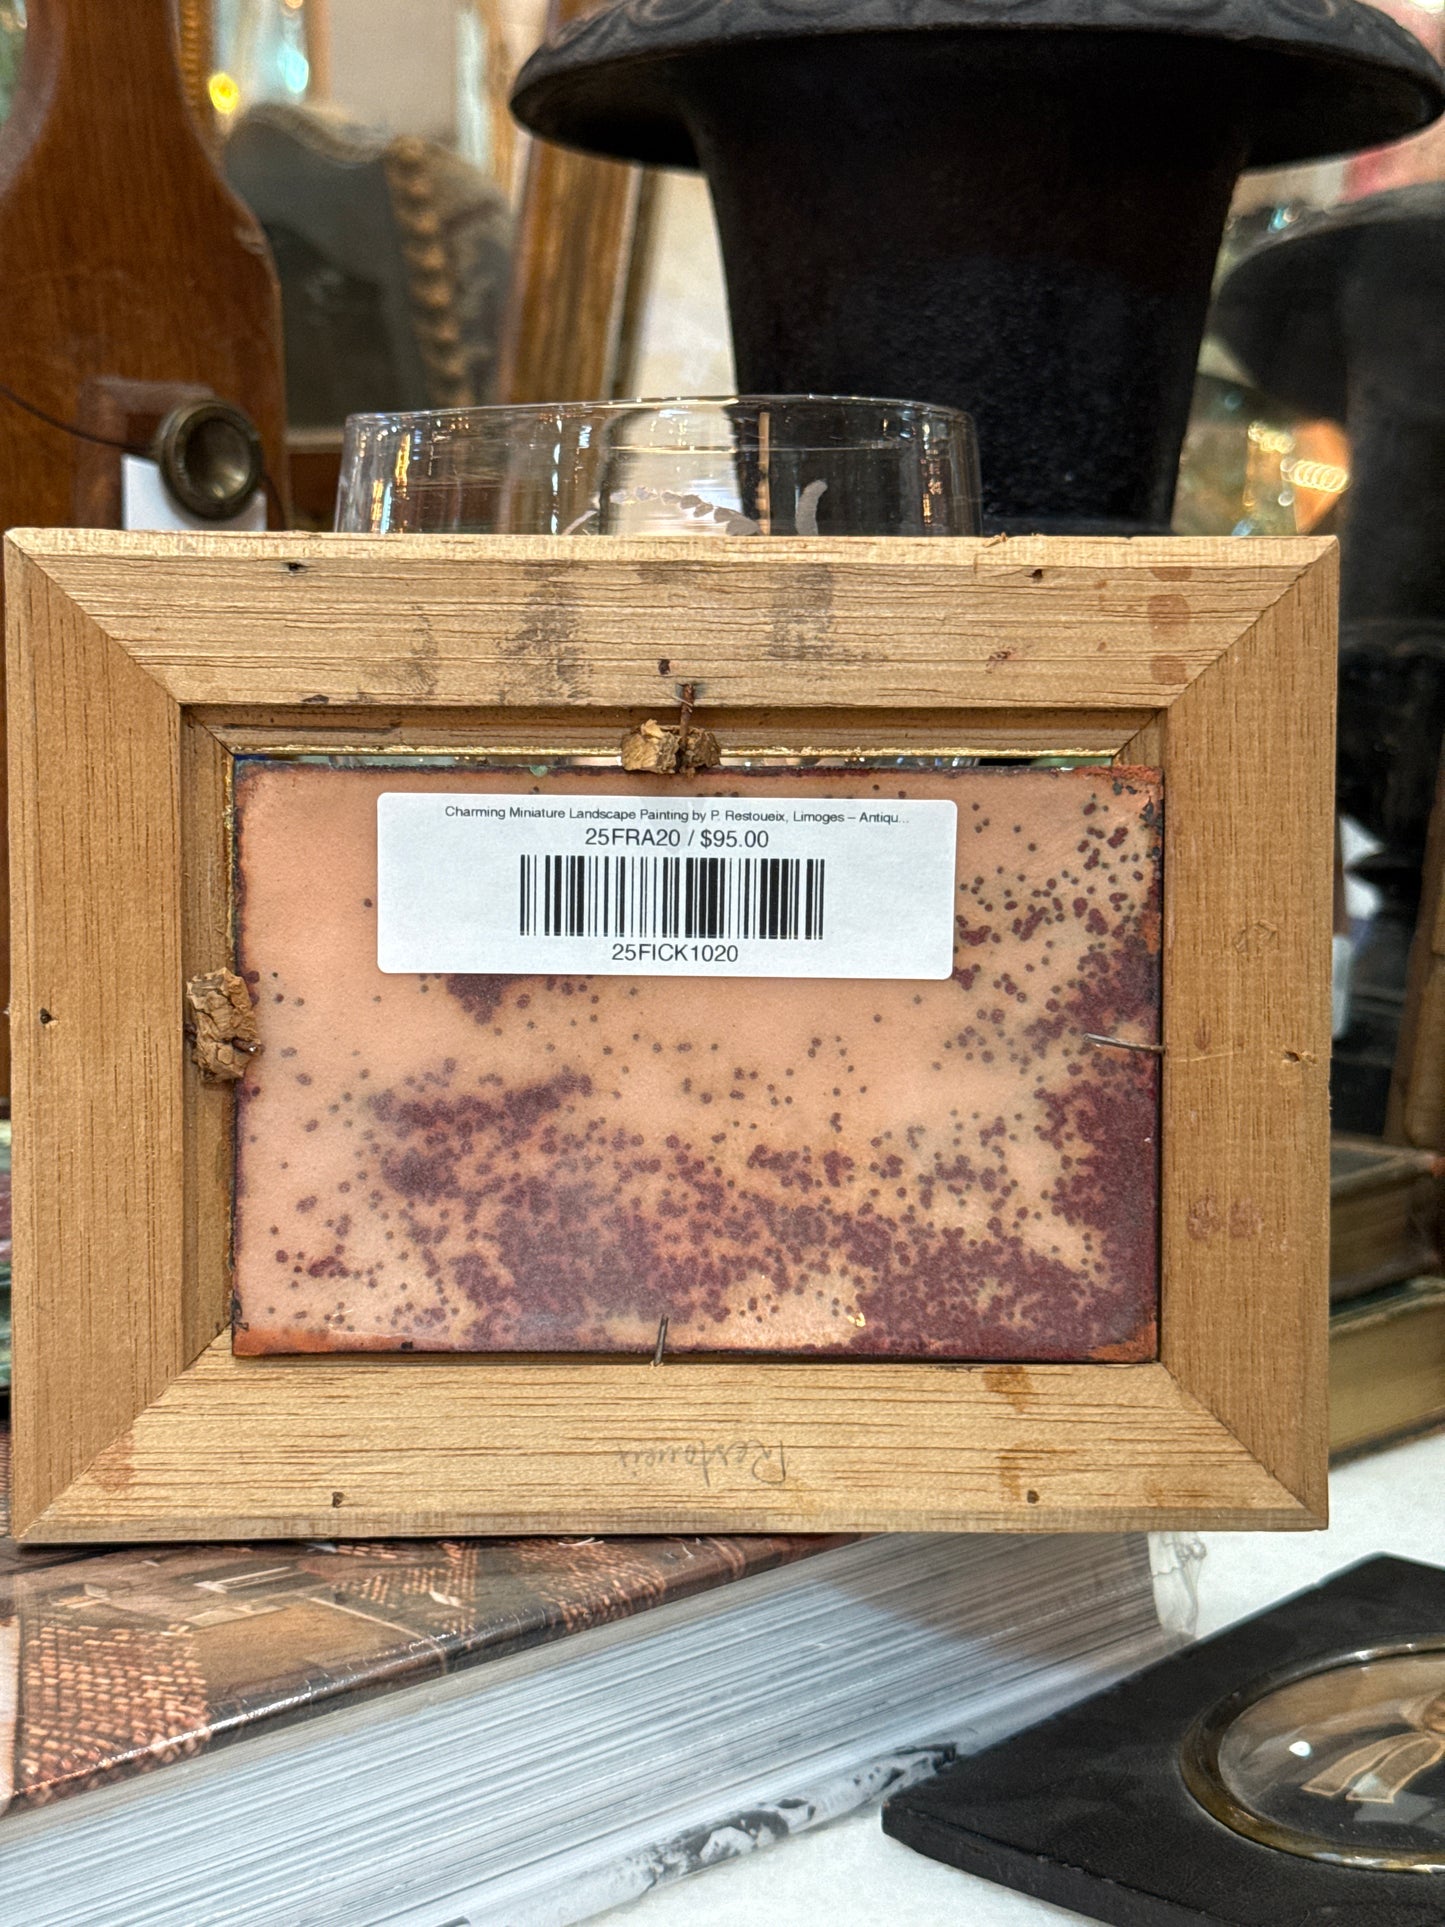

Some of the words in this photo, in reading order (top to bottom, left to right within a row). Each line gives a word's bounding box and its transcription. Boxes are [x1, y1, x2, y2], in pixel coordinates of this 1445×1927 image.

[445, 805, 506, 820] Charming
[509, 806, 566, 819] Miniature
[569, 807, 637, 822] Landscape
[640, 808, 689, 824] Painting
[692, 809, 707, 823] by
[710, 809, 721, 821] P.
[725, 810, 789, 824] Restoueix,
[793, 811, 845, 825] Limoges
[585, 828, 681, 847] 25FRA20
[687, 829, 695, 847] /
[700, 829, 769, 849] $95.00
[611, 943, 739, 963] 25FICK1020
